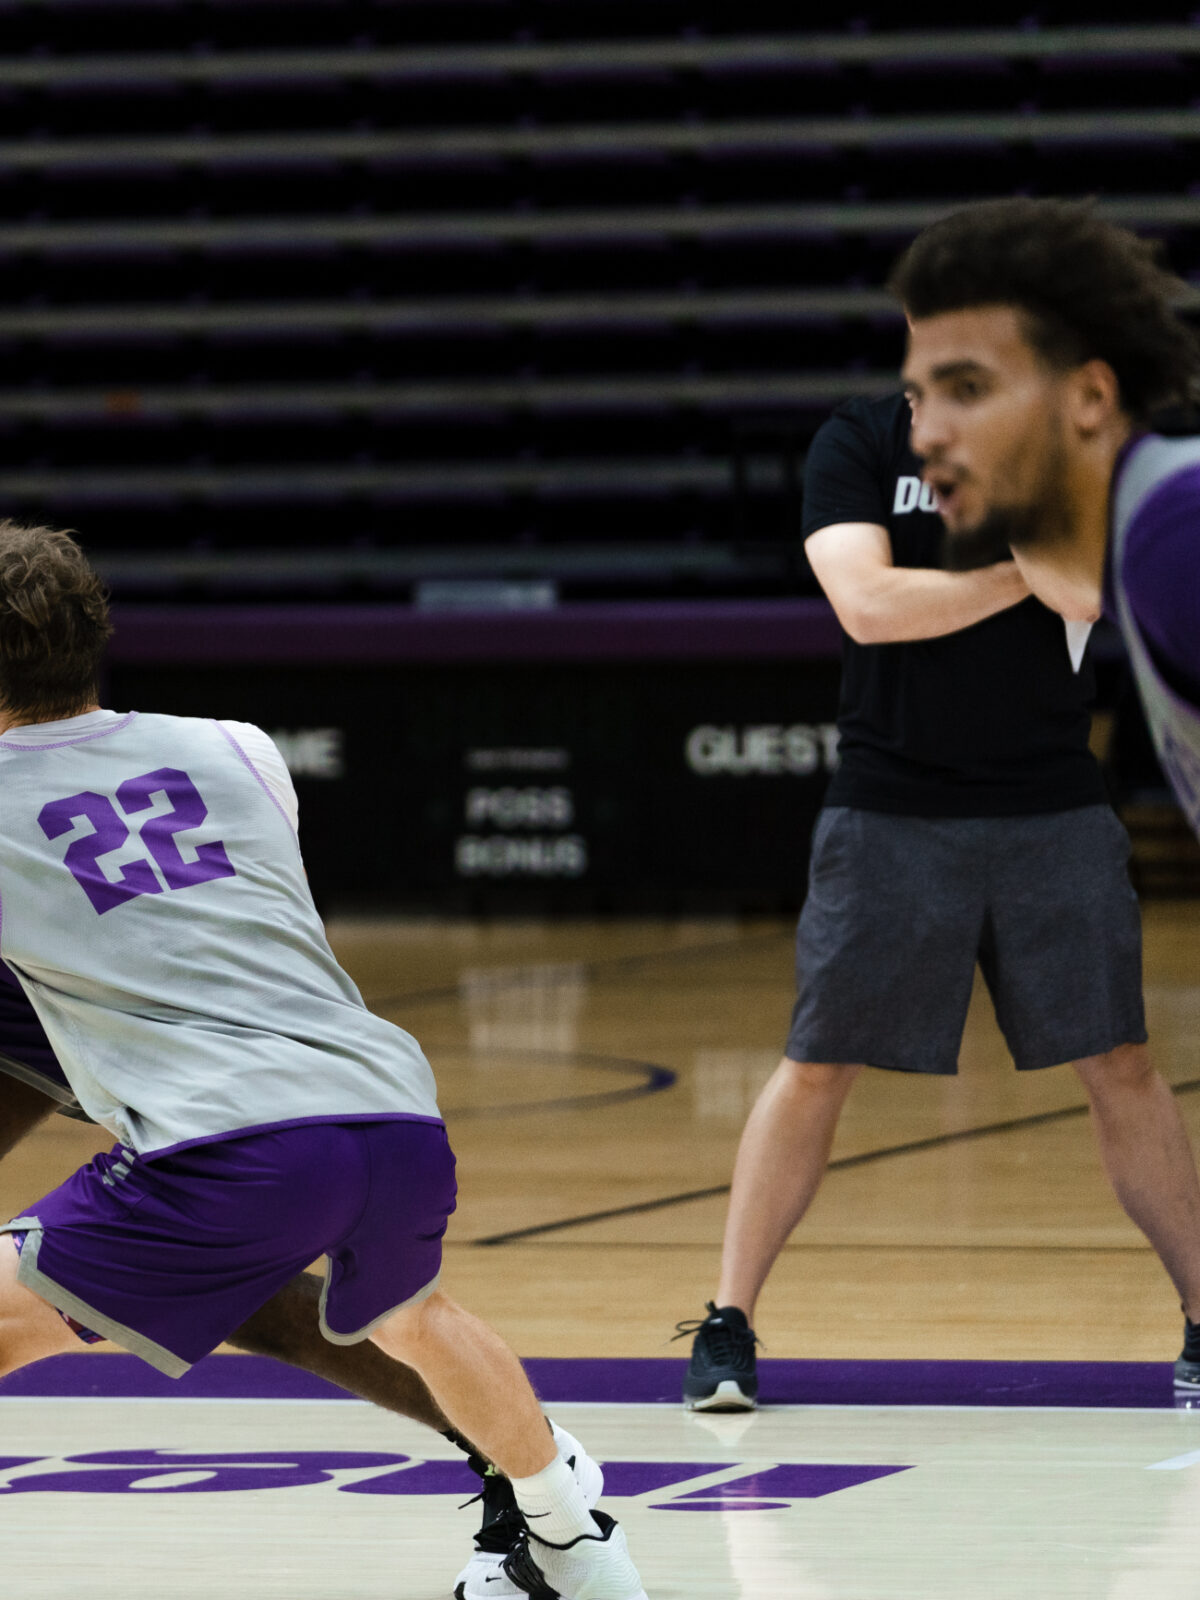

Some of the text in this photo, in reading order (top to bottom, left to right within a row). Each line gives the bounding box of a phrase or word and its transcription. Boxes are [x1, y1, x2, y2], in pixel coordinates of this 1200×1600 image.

[274, 728, 341, 778] ME
[686, 724, 841, 775] GUEST
[37, 767, 236, 915] 22
